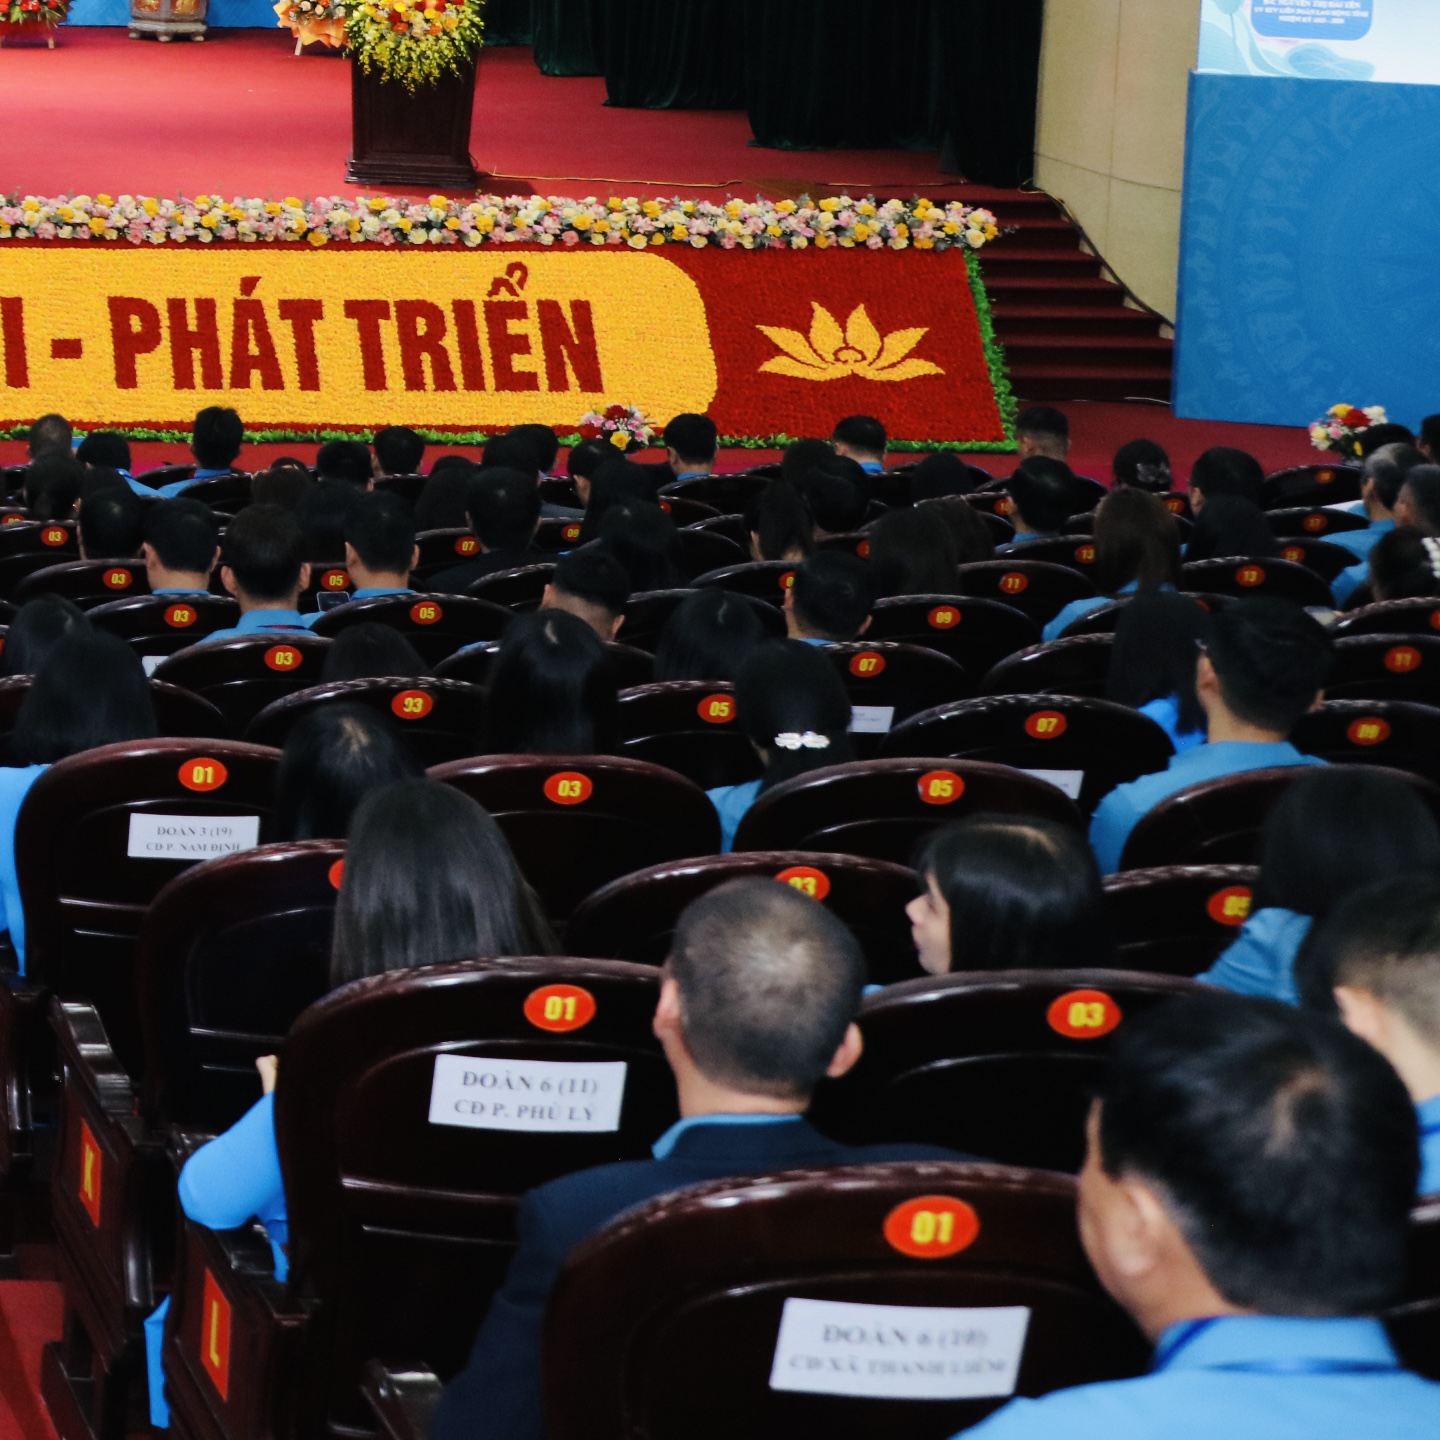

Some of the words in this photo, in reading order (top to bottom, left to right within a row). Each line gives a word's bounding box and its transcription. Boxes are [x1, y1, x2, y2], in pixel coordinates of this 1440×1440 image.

[116, 275, 325, 393] PHÁT
[344, 262, 604, 393] TRIỂN
[936, 612, 952, 623] 09
[275, 652, 293, 665] 03
[859, 658, 877, 671] 07
[403, 697, 423, 712] 03
[193, 766, 214, 784] 01
[558, 780, 582, 797] 03
[929, 779, 953, 797] 05
[200, 827, 206, 836] 3
[544, 996, 576, 1020] 01
[1068, 1002, 1105, 1027] 03
[911, 1211, 954, 1244] 01
